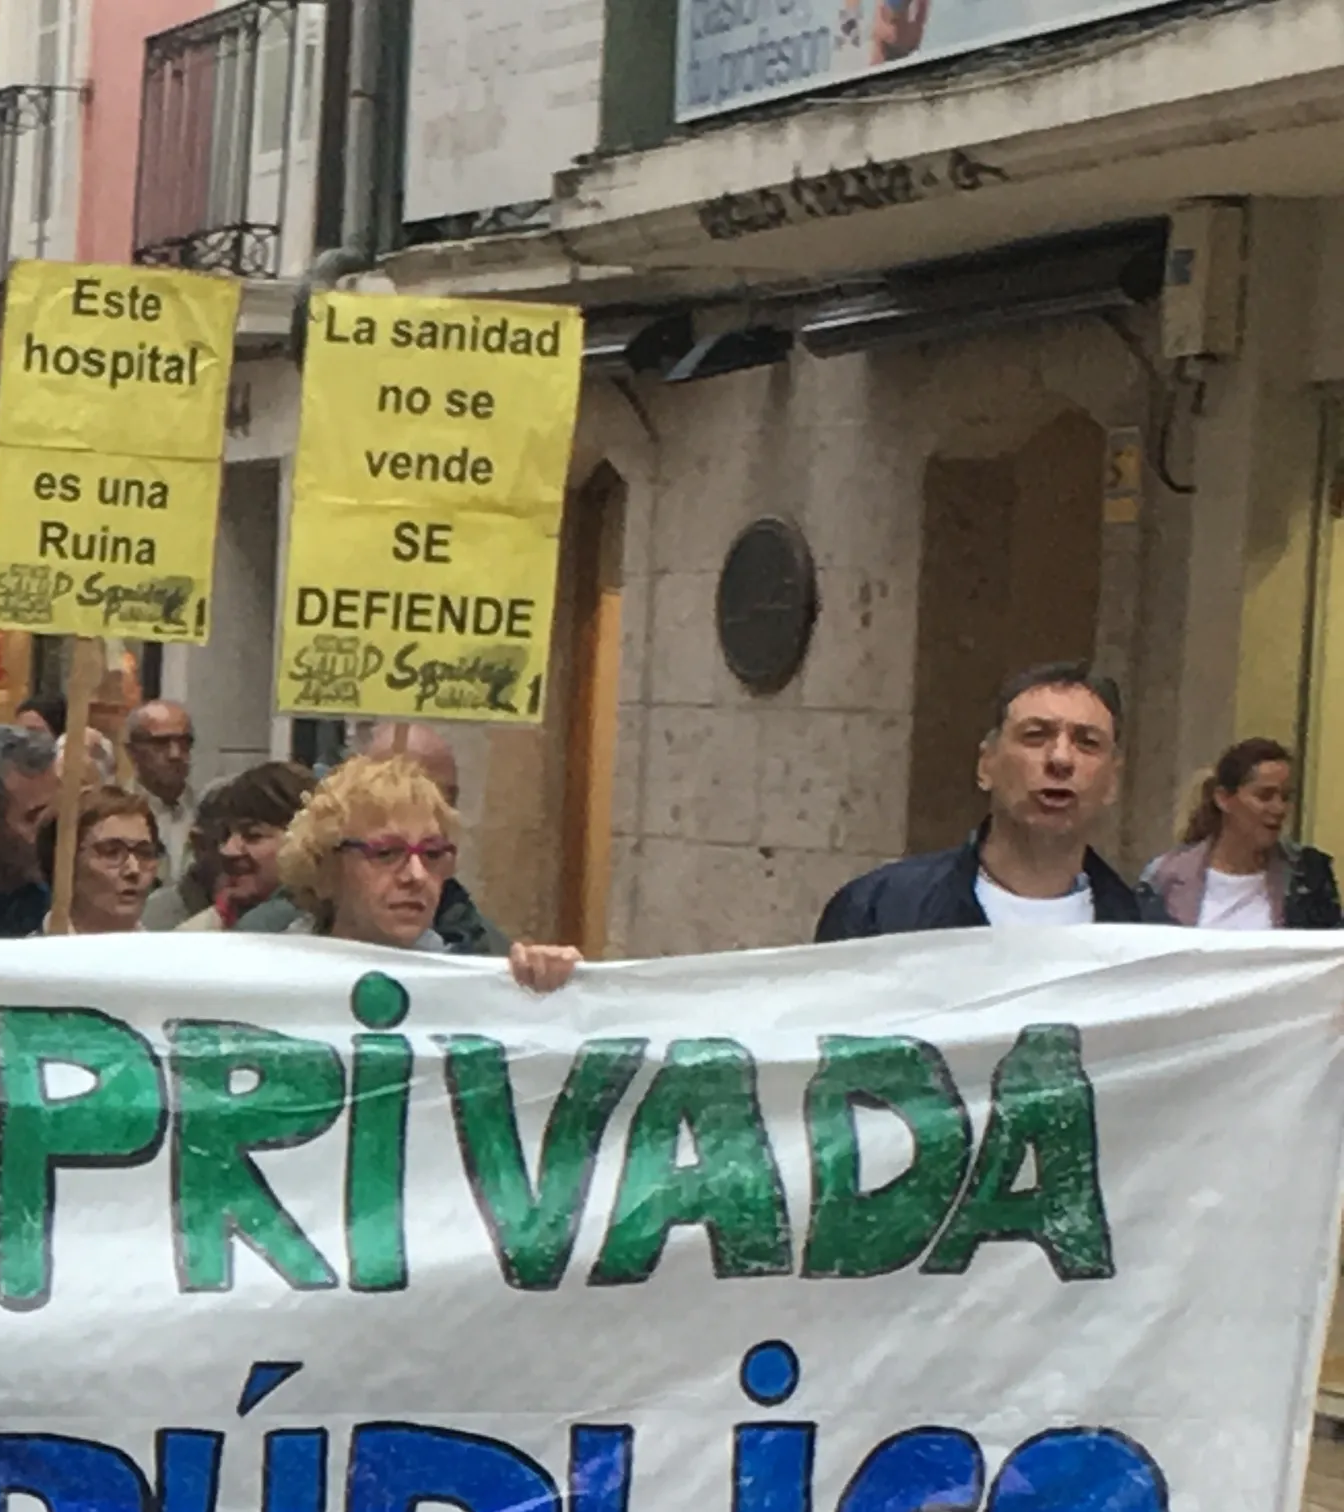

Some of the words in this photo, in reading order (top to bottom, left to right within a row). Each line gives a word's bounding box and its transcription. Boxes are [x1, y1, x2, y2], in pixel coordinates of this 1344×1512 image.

[72, 278, 162, 322] Este
[325, 304, 377, 346] La
[390, 315, 561, 357] sanidad
[23, 332, 199, 390] hospital
[378, 384, 431, 415] no
[444, 388, 495, 419] se
[365, 446, 494, 485] vende
[34, 471, 81, 502] es
[98, 475, 169, 510] una
[38, 520, 156, 566] Ruina
[392, 521, 453, 564] SE
[295, 587, 535, 639] DEFIENDE
